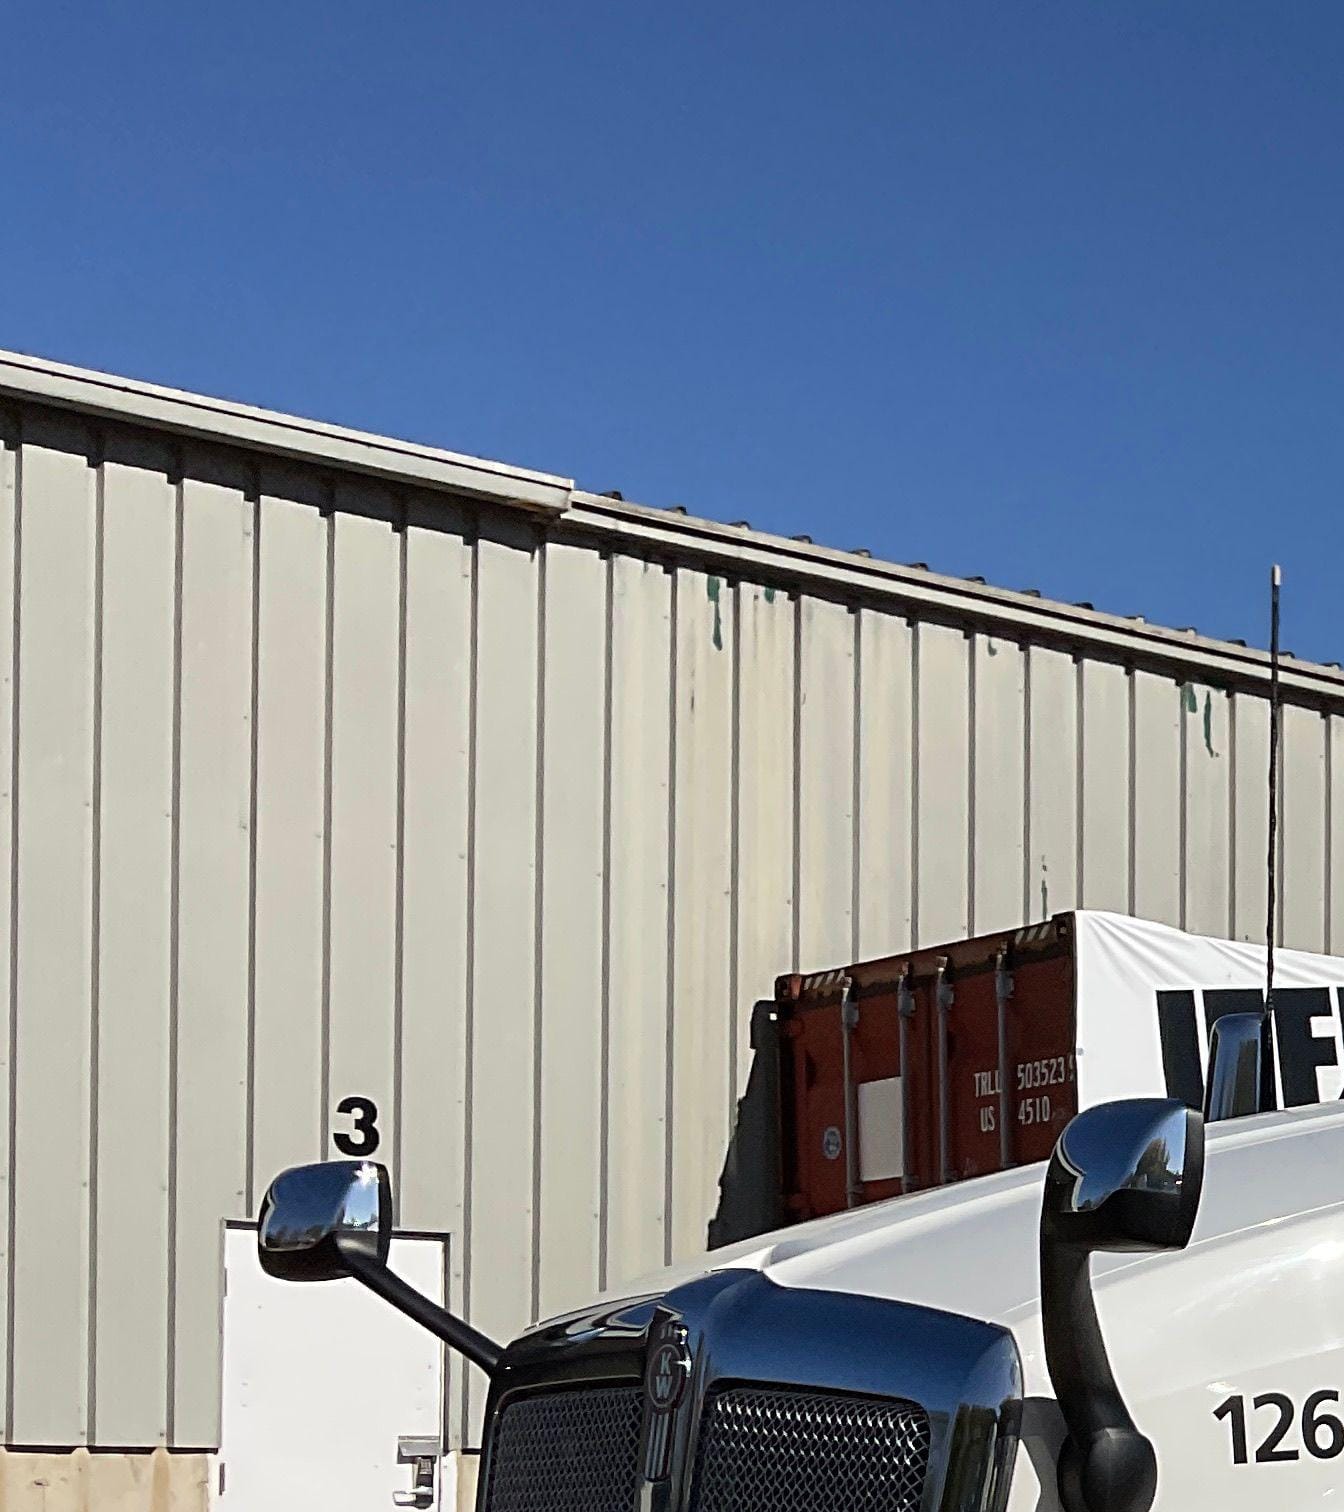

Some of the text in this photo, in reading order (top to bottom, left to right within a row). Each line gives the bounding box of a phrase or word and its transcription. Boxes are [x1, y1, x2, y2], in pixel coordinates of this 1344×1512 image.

[1017, 1056, 1065, 1090] 503523
[333, 1096, 380, 1156] 3
[980, 1095, 1051, 1132] US 4510
